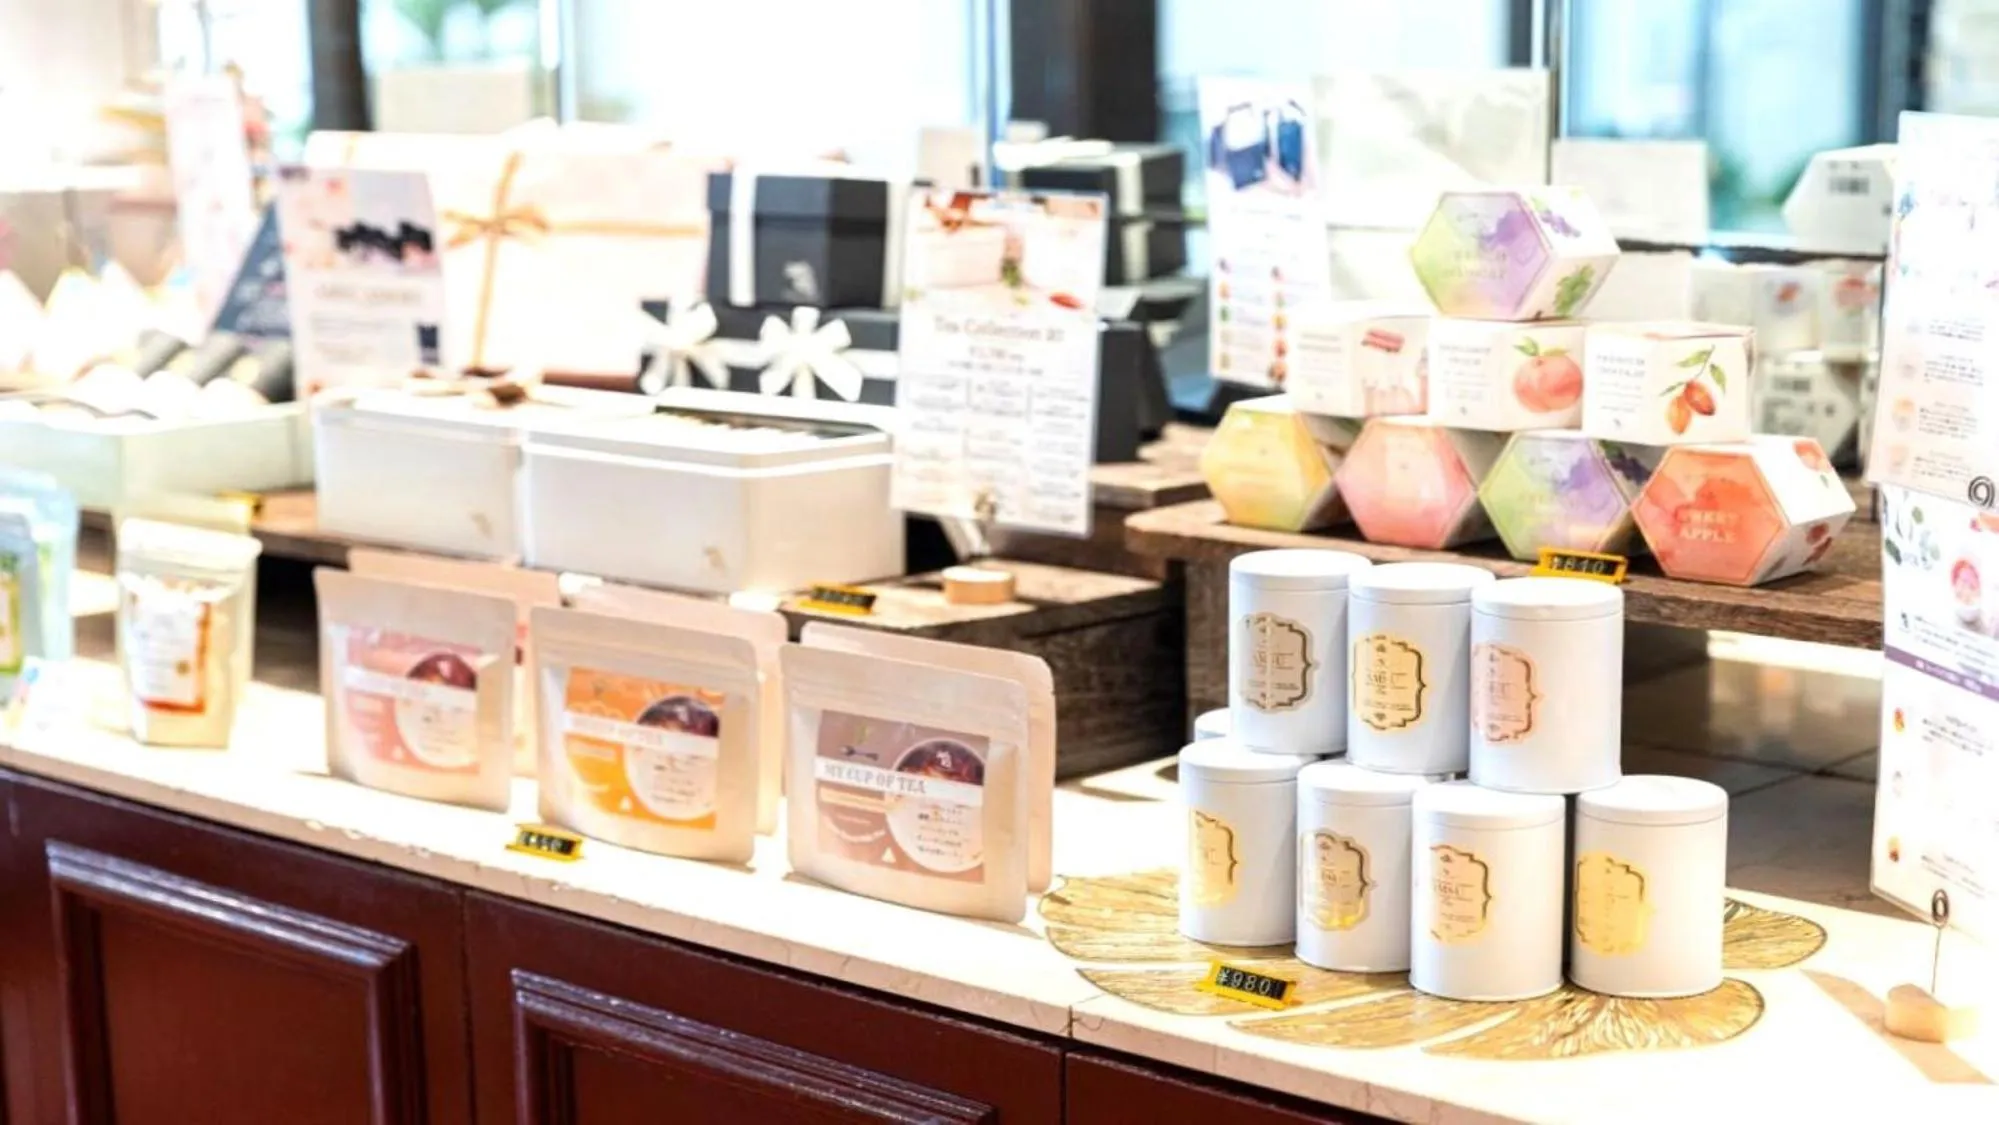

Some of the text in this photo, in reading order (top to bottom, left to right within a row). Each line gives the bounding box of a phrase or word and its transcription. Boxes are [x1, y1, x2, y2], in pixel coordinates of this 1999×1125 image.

[824, 763, 927, 793] MY CUP OF TEA
[1218, 966, 1271, 995] ¥980
